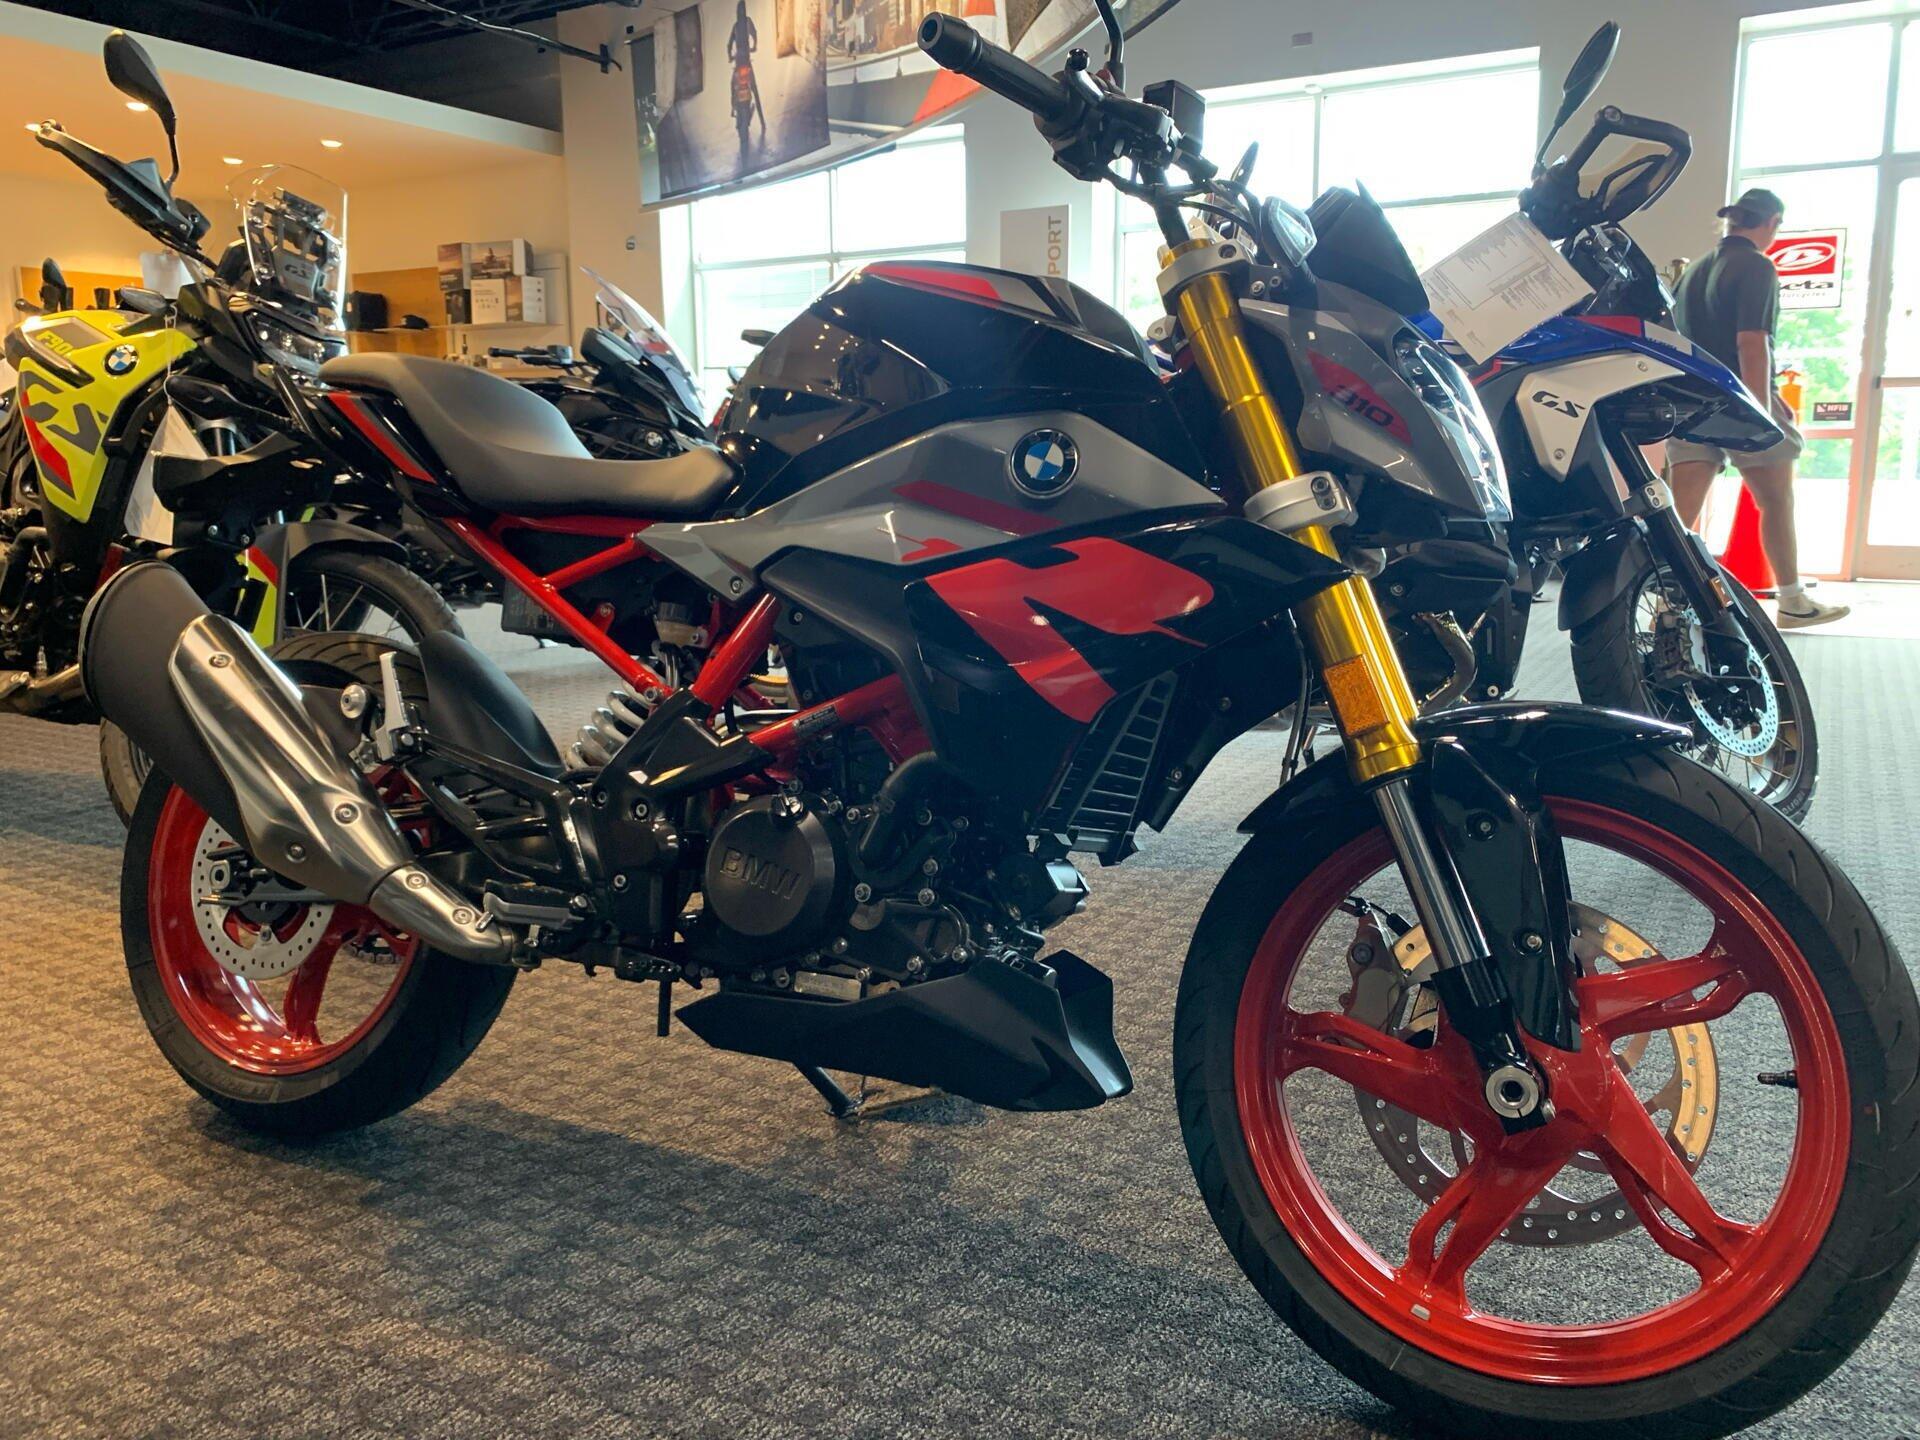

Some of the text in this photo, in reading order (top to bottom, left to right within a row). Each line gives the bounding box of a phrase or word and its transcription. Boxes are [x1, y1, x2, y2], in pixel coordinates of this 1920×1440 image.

[1047, 215, 1062, 276] PORT
[1780, 280, 1834, 291] eta
[35, 330, 73, 357] F90
[1532, 390, 1586, 419] GS
[720, 846, 802, 900] BMW
